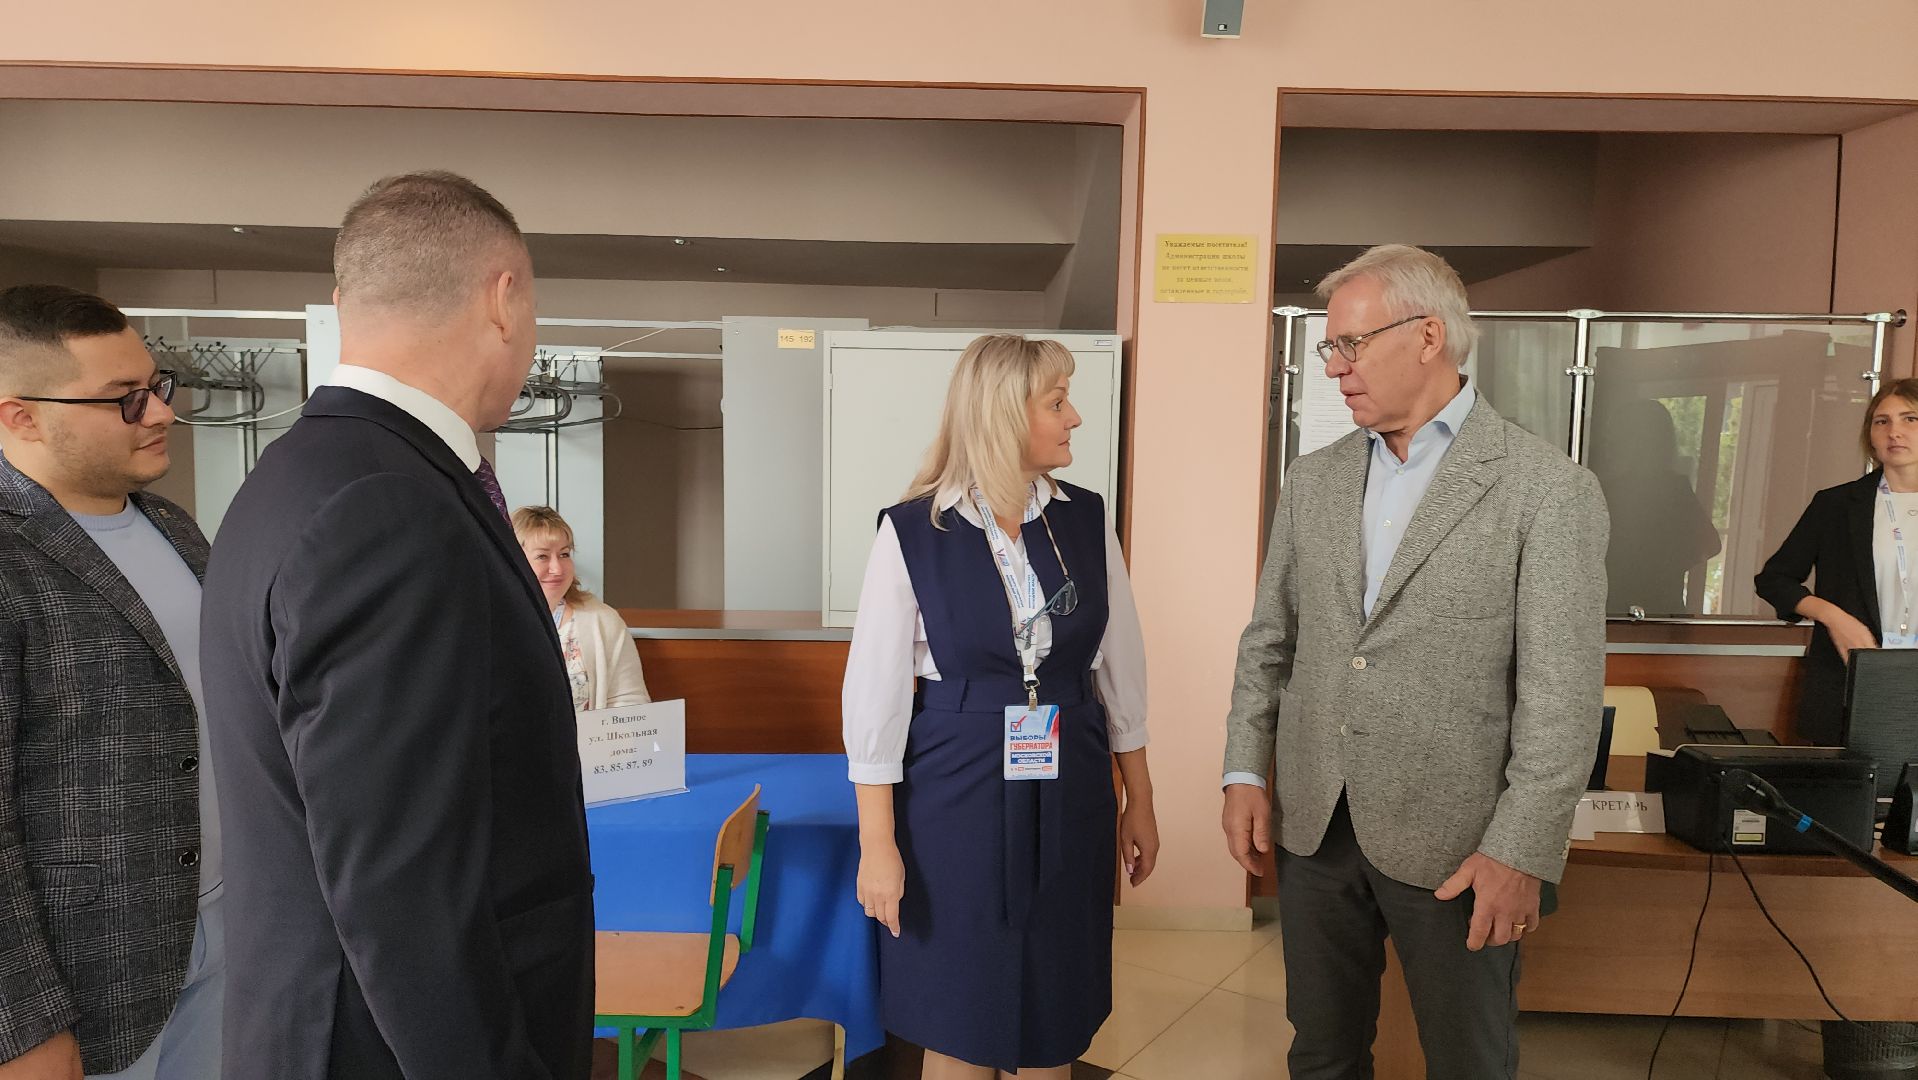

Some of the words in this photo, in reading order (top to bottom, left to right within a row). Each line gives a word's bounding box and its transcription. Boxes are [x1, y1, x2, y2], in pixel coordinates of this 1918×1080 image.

[1164, 240, 1205, 248] Уважаемые
[612, 714, 647, 725] Видное
[587, 735, 604, 745] ул.
[606, 728, 658, 741] Школьная
[1010, 742, 1053, 750] ГУБЕРНАТОРА
[610, 747, 638, 757] дома:
[593, 765, 608, 775] 83,
[609, 762, 624, 773] 85,
[626, 760, 640, 770] 87,
[642, 758, 653, 768] 89
[1592, 800, 1648, 812] КРЕТАРЬ
